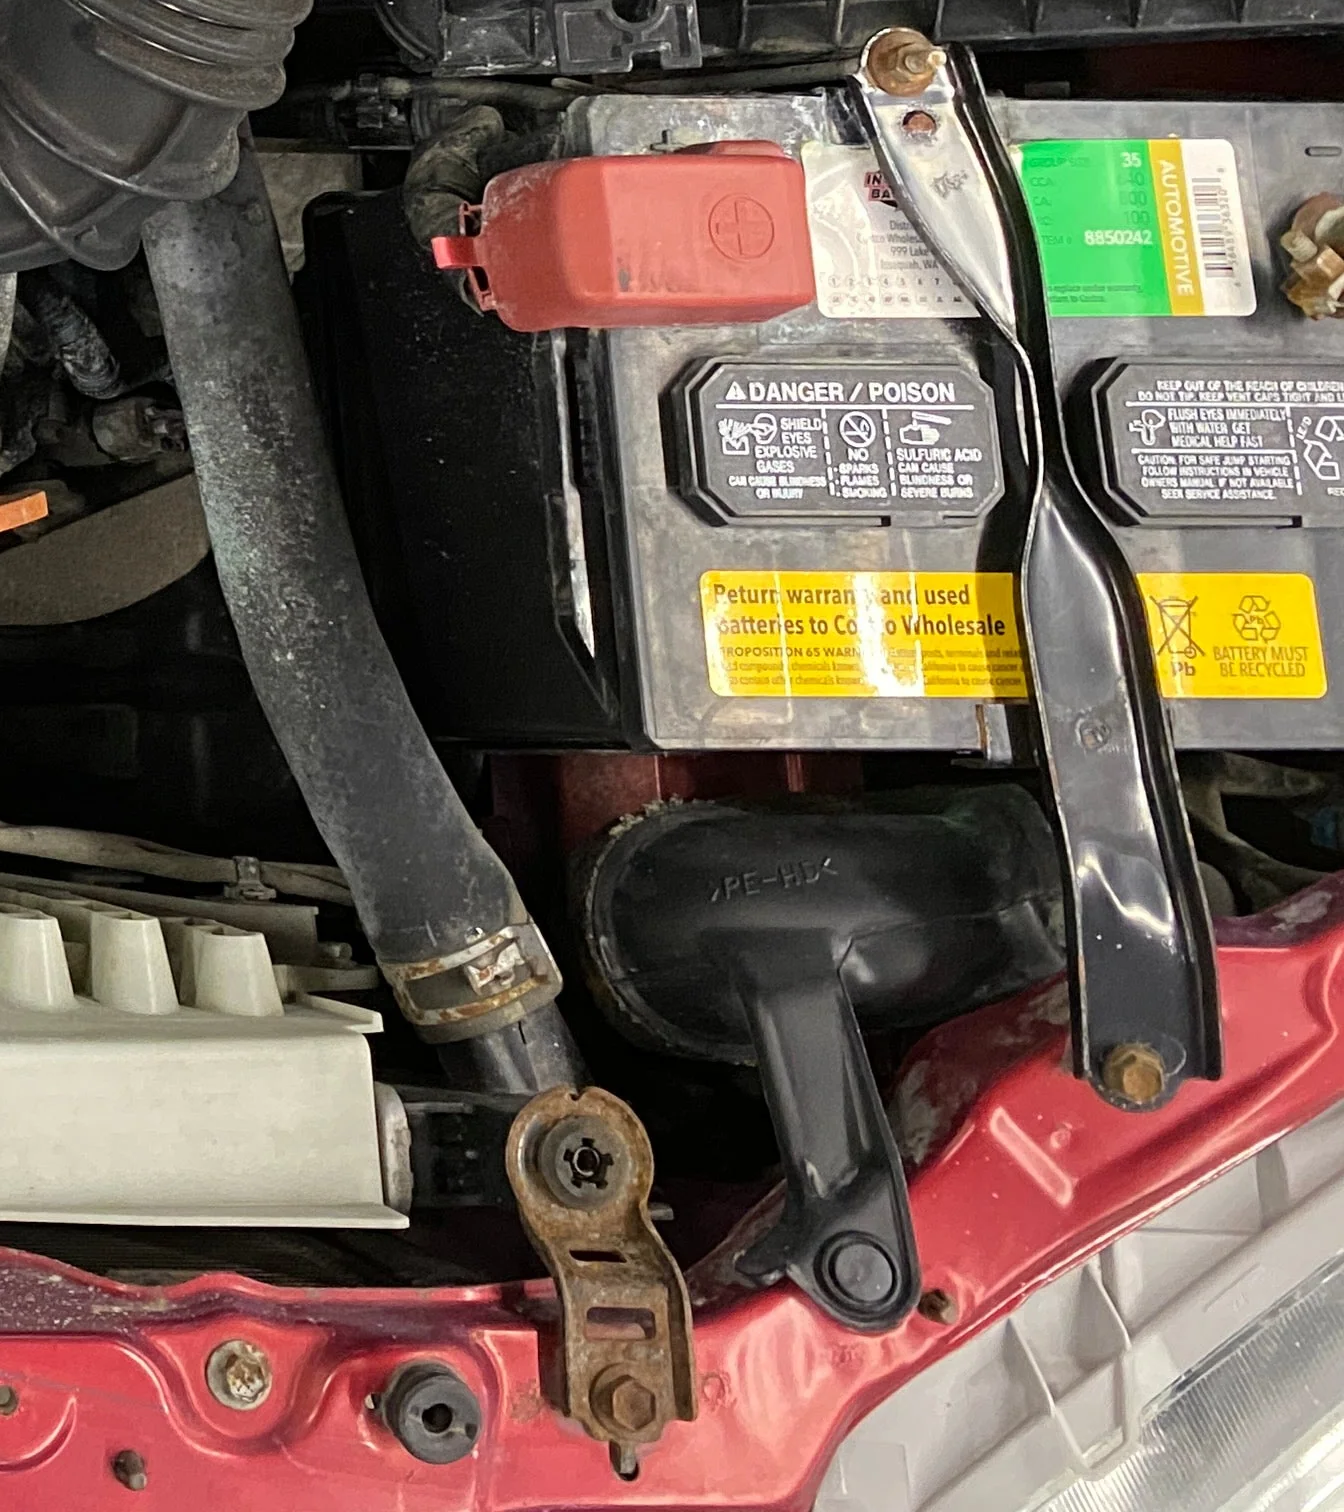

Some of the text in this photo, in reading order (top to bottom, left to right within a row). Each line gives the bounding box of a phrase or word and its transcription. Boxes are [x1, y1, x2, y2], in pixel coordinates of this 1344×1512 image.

[1121, 152, 1142, 168] 35
[1157, 159, 1195, 296] AUTOMOTIVE
[1041, 236, 1064, 245] TEM
[1084, 229, 1153, 245] 8850242
[890, 246, 908, 256] 999
[749, 382, 956, 402] DANGER / POISON
[1137, 391, 1153, 401] DO
[1155, 391, 1175, 402] NOT
[1167, 408, 1286, 422] FLUSH EYES IMMEDIATELY
[781, 419, 822, 432] SHIELD
[1169, 422, 1251, 434] WITH WATER GET
[782, 432, 812, 445] EYES
[1171, 435, 1263, 447] MEDICAL HELP FAST
[754, 445, 817, 459] EXPLOSIVE
[848, 448, 869, 462] NO
[896, 448, 983, 462] SULFURIC ACID
[756, 460, 795, 474] GASES
[1179, 455, 1197, 465] FOR
[839, 464, 879, 474] SPARKS
[898, 463, 955, 474] CAN CAUSE
[840, 475, 880, 486] FLAMES
[841, 487, 888, 499] SMOKING
[713, 584, 780, 604] Return
[881, 585, 919, 605] and
[924, 584, 970, 605] used
[809, 616, 829, 635] to
[900, 614, 1005, 636] Wholesale
[805, 647, 820, 657] 65
[1213, 646, 1309, 661] BATTERY MUST
[1171, 661, 1196, 676] Pb
[1219, 663, 1306, 677] BE RECYCLED
